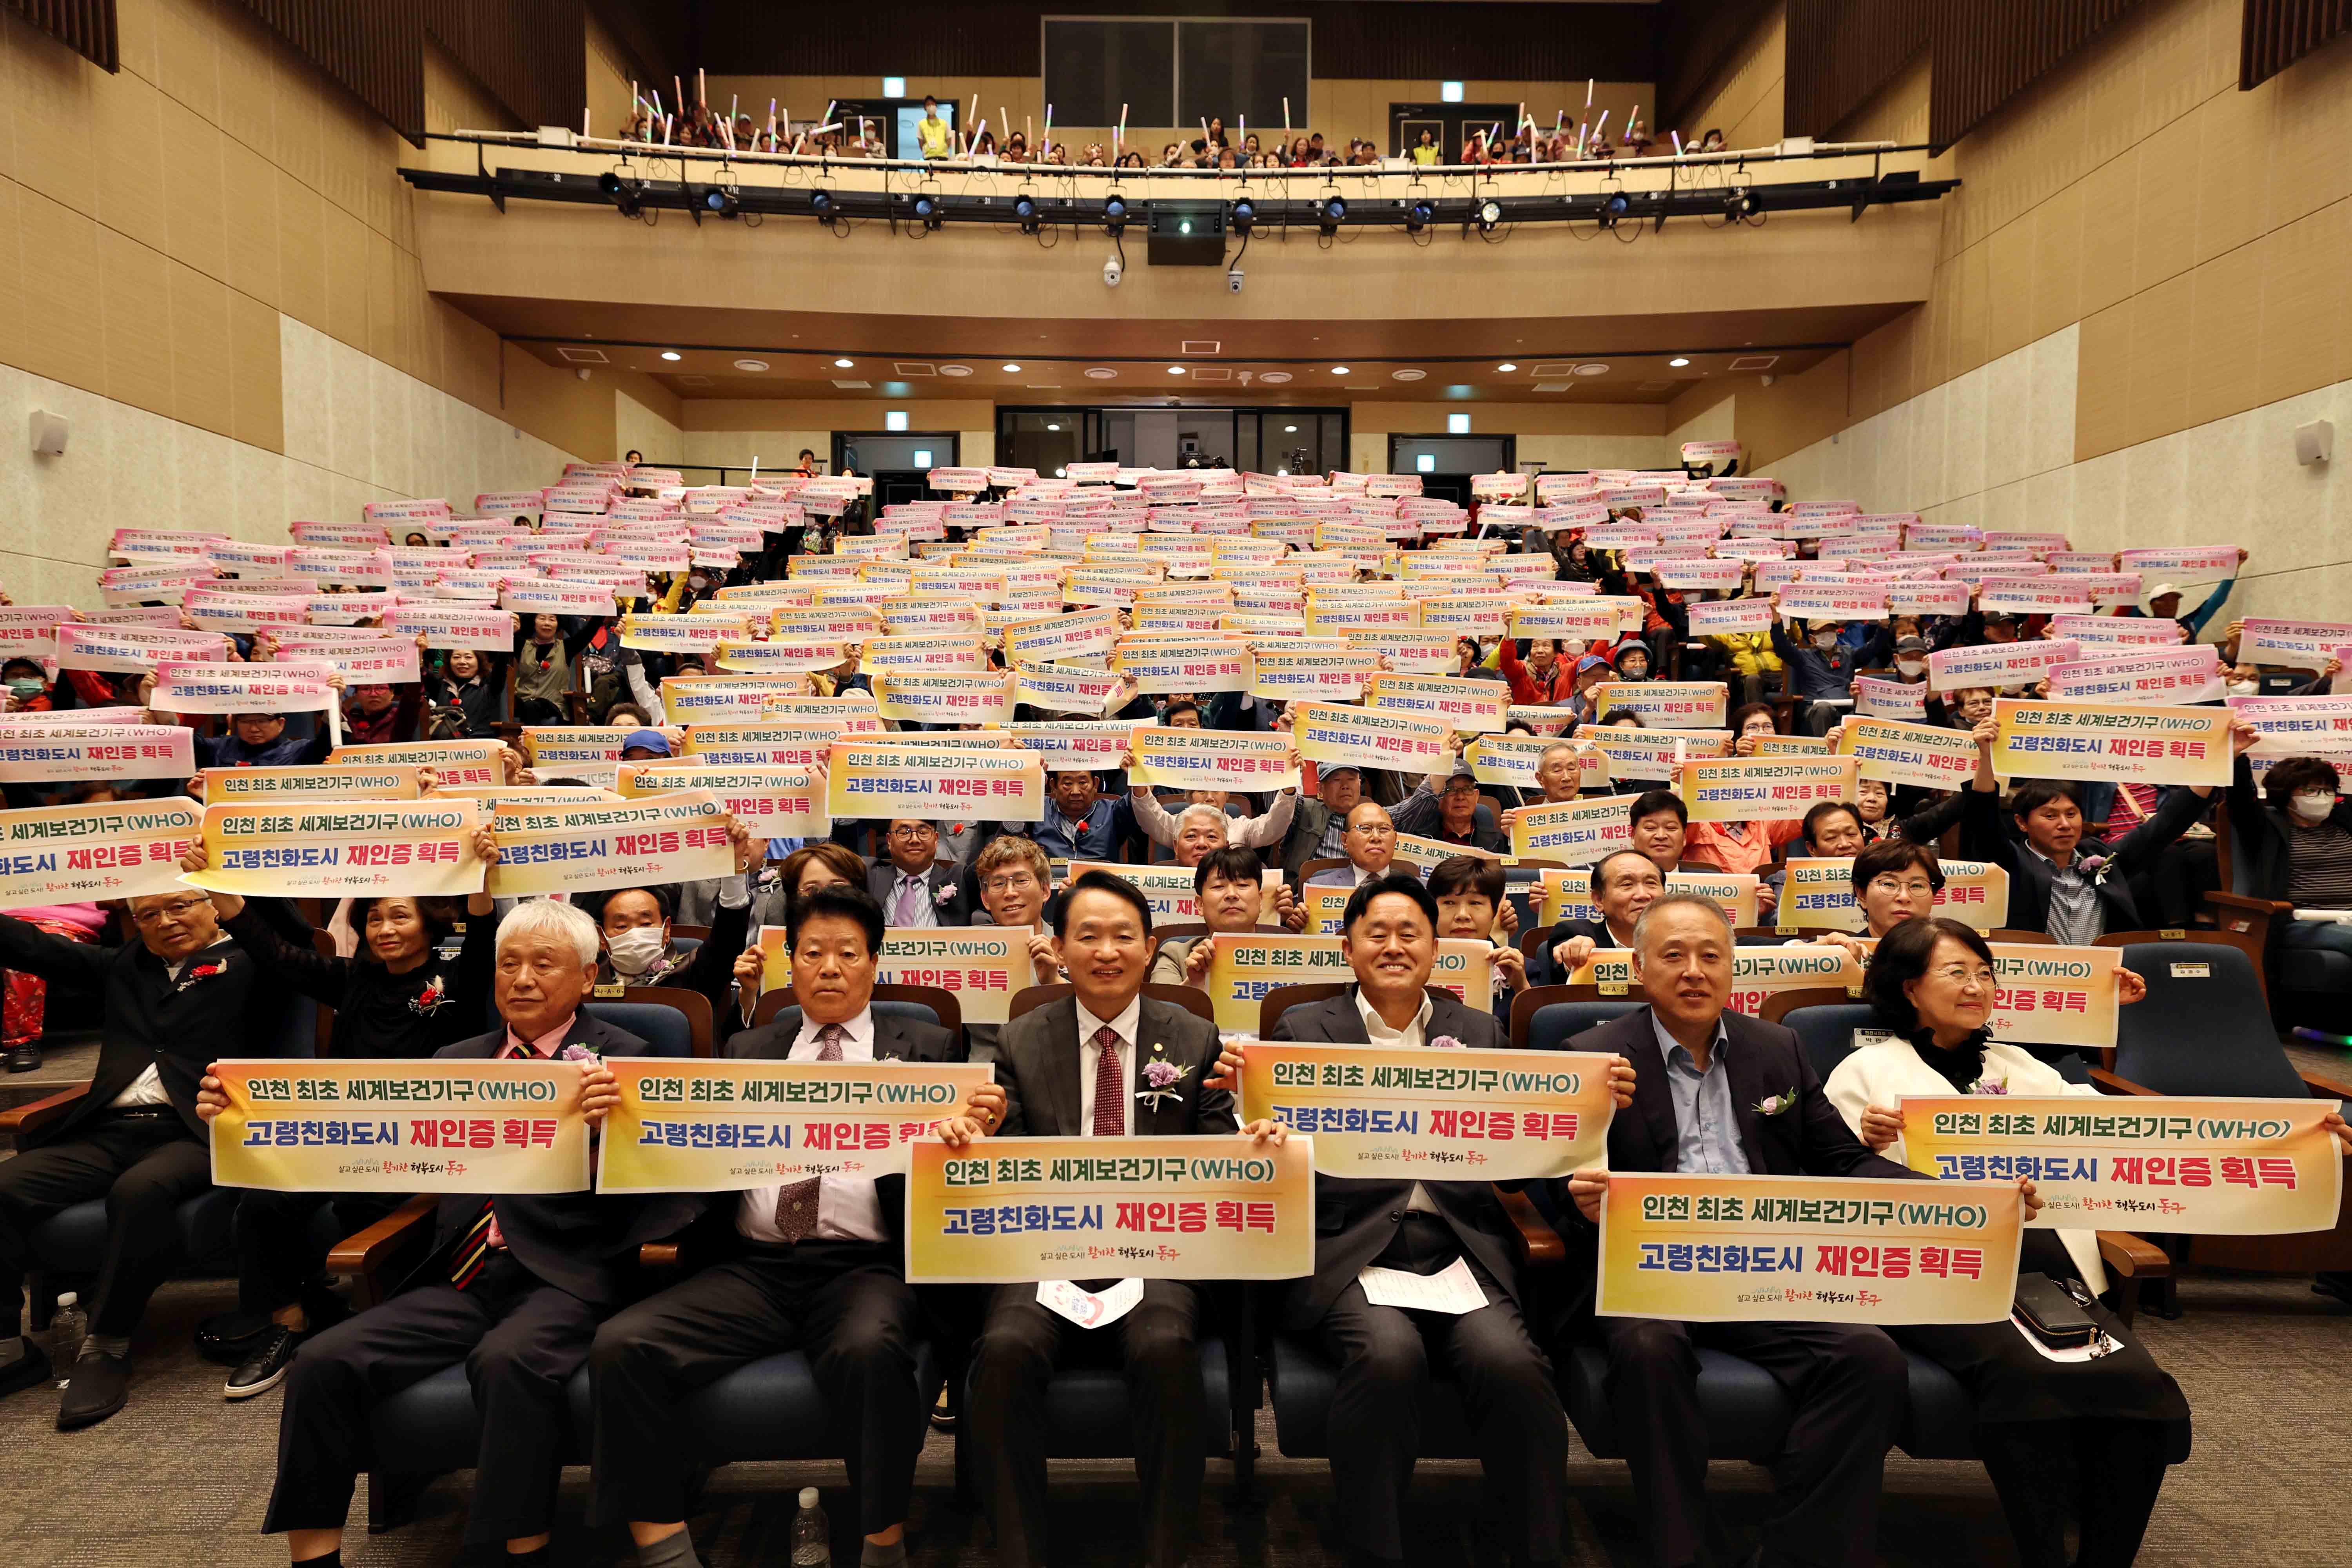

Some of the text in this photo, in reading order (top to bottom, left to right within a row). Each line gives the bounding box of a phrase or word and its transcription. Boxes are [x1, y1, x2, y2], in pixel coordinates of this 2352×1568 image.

[1315, 612, 1409, 623] 고령친화도시 재인증 획득
[170, 668, 319, 679] 인천 최초 세계보건기구(WHO)
[2061, 658, 2205, 679] 인천 최초 세계보건기구(WHO)
[171, 684, 318, 697] 고령친화도시 재인증 획득
[2063, 674, 2206, 697] 고령친화도시 재인증 획득
[2015, 710, 2211, 732] 인천 최초 세계보건기구(WHO)
[2007, 736, 2205, 759] 고령친화도시 재인증 획득
[848, 752, 1024, 770] 인천 최초 세계보건기구(WHO)
[1698, 766, 1843, 779] 인천 최초 세계보건기구(WHO)
[846, 778, 1024, 797] 고령친화도시 재인증 획득
[1696, 784, 1841, 801] 고령친화도시 재인증 획득
[11, 812, 193, 840] 세계보건기구(WHO)
[222, 814, 460, 834] 인천 최초 세계보건기구(WHO)
[494, 802, 721, 832] 인천 최초 세계보건기구(WHO)
[67, 840, 193, 870] 재인증 획득
[222, 842, 459, 869] 고령친화도시 재인증 획득
[496, 826, 726, 865] 고령친화도시 재인증 획득
[1273, 1061, 1580, 1094] 인천 최초 세계보건기구(WHO)
[248, 1080, 557, 1103] 인천 최초 세계보건기구(WHO)
[639, 1077, 957, 1106] 인천 최초 세계보건기구(WHO)
[244, 1118, 556, 1149] 고령친화도시 재인증 획득
[640, 1118, 952, 1151] 고령친화도시 재인증 획
[1273, 1106, 1578, 1141] 고령친화도시 재인증 획득
[1933, 1112, 2291, 1139] 인천 최초 세계보건기구(WHO)
[944, 1159, 1274, 1185] 인천 최초 세계보건기구(WHO)
[1933, 1155, 2293, 1189] 고령친화도시 재인증 획득
[944, 1201, 1275, 1235] 고령친화도시 재인증 획득
[1644, 1194, 1987, 1228] 인천 최초 세계보건기구(WHO)
[2082, 1197, 2114, 1210] 활기찬
[2115, 1199, 2155, 1212] 행복도시
[2157, 1198, 2186, 1214] 동구
[1637, 1243, 1981, 1279] 고령친화도시 재인증 획득
[1784, 1289, 1813, 1302] 활기찬
[1815, 1290, 1853, 1304] 행복도시
[1856, 1290, 1882, 1307] 동구
